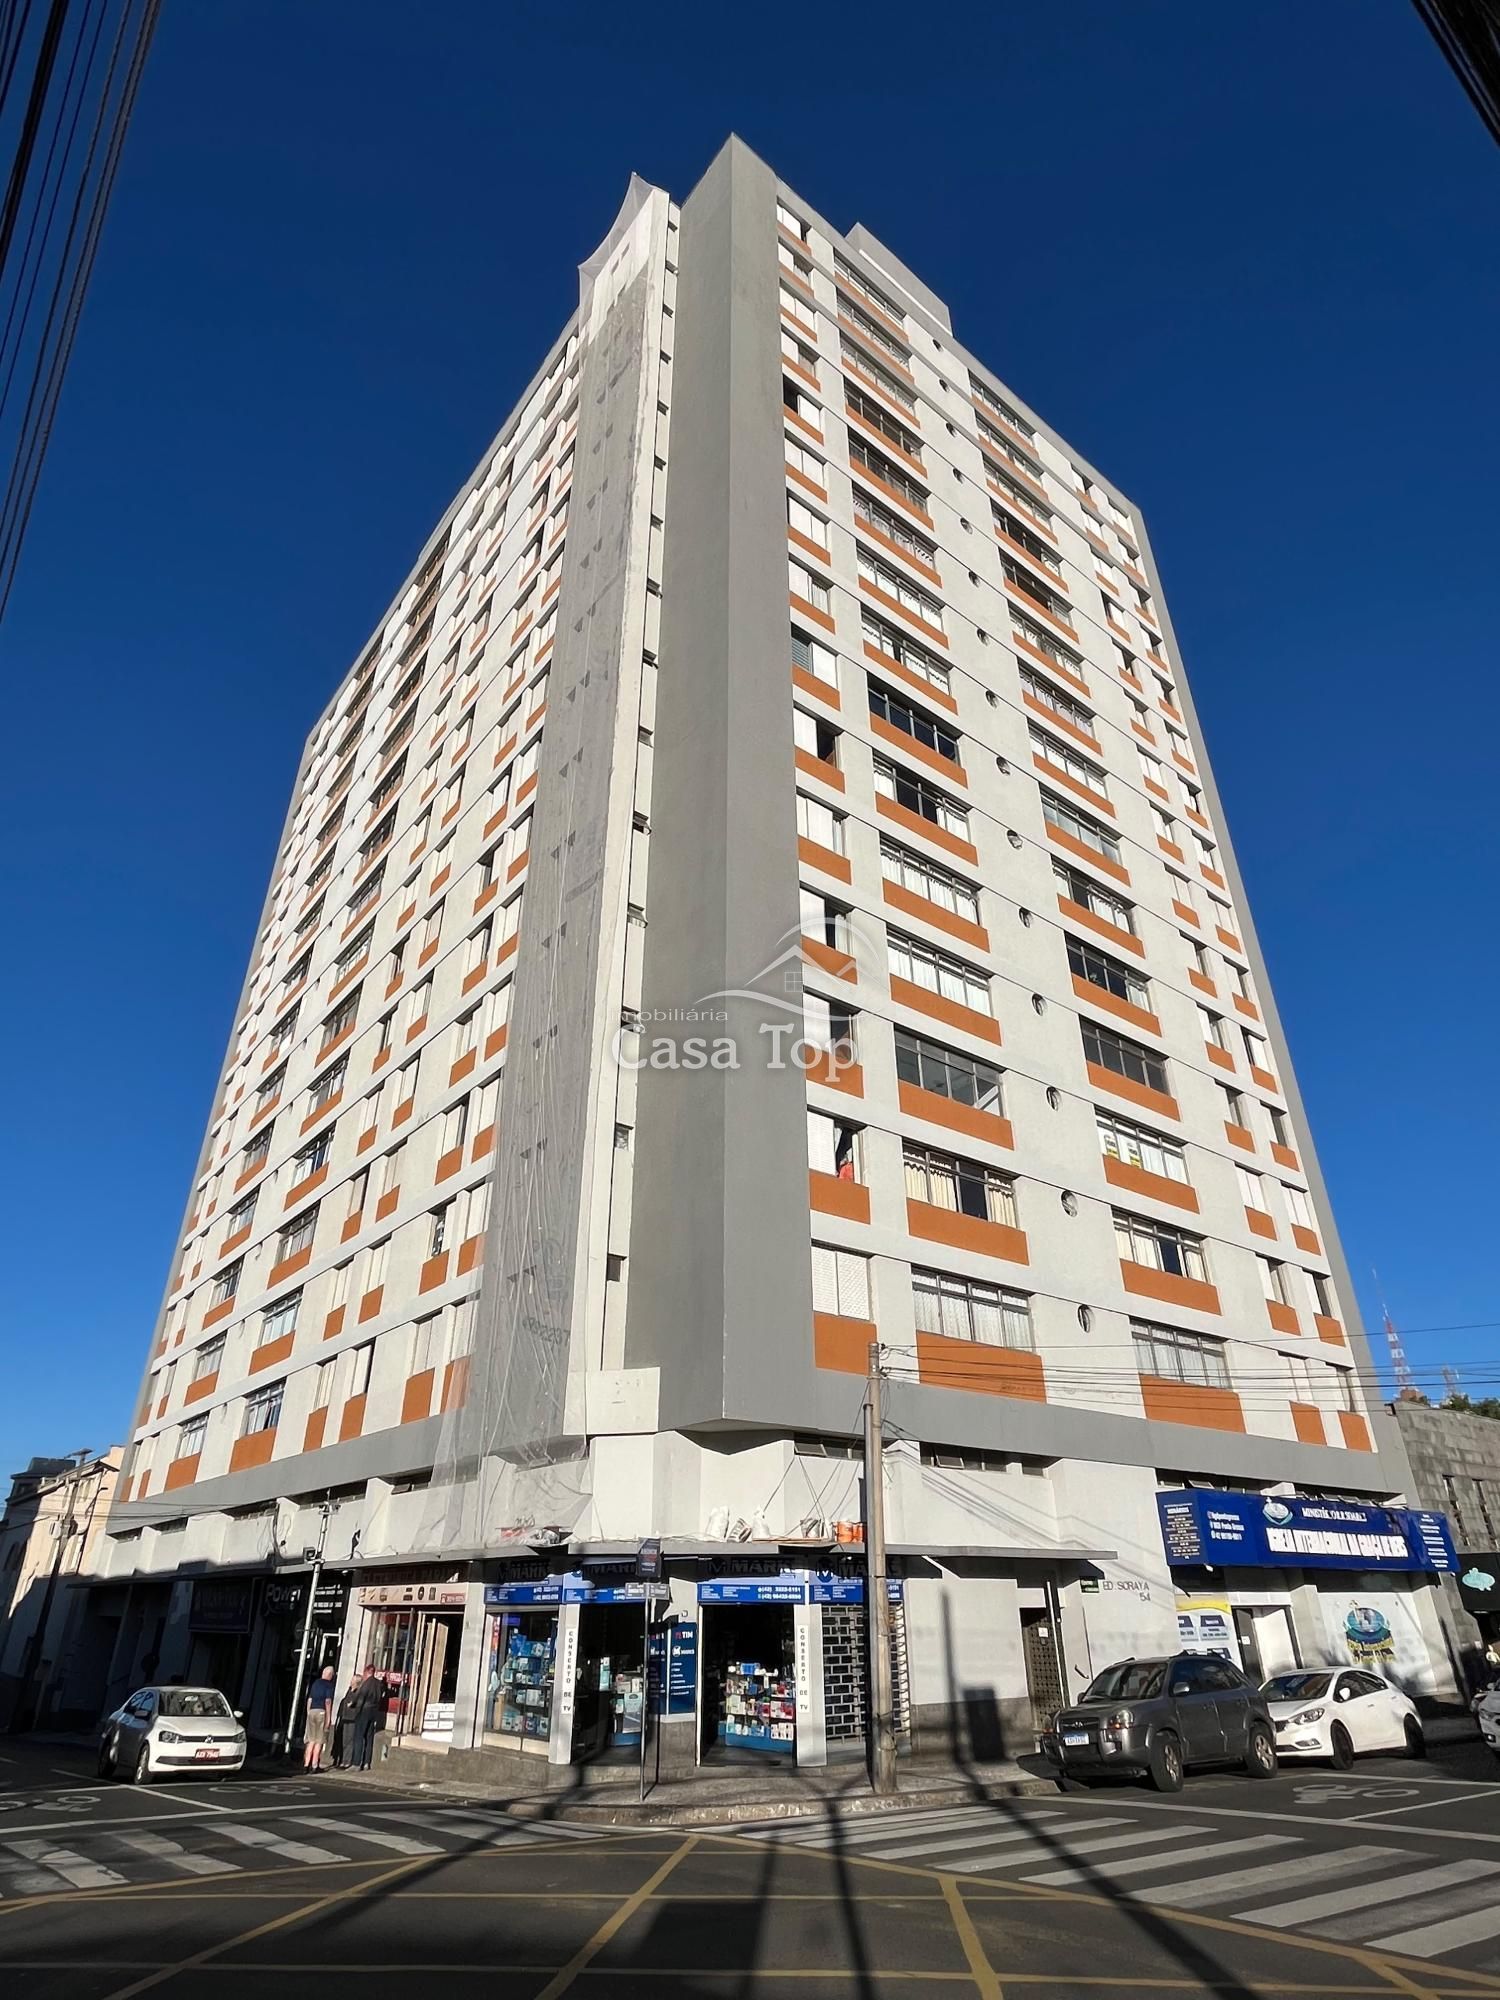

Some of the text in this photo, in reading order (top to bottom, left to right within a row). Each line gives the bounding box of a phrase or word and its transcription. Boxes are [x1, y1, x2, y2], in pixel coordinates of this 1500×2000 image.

[1117, 1580, 1150, 1591] SORAYA
[1139, 1592, 1151, 1602] 54
[682, 1631, 694, 1639] TIM
